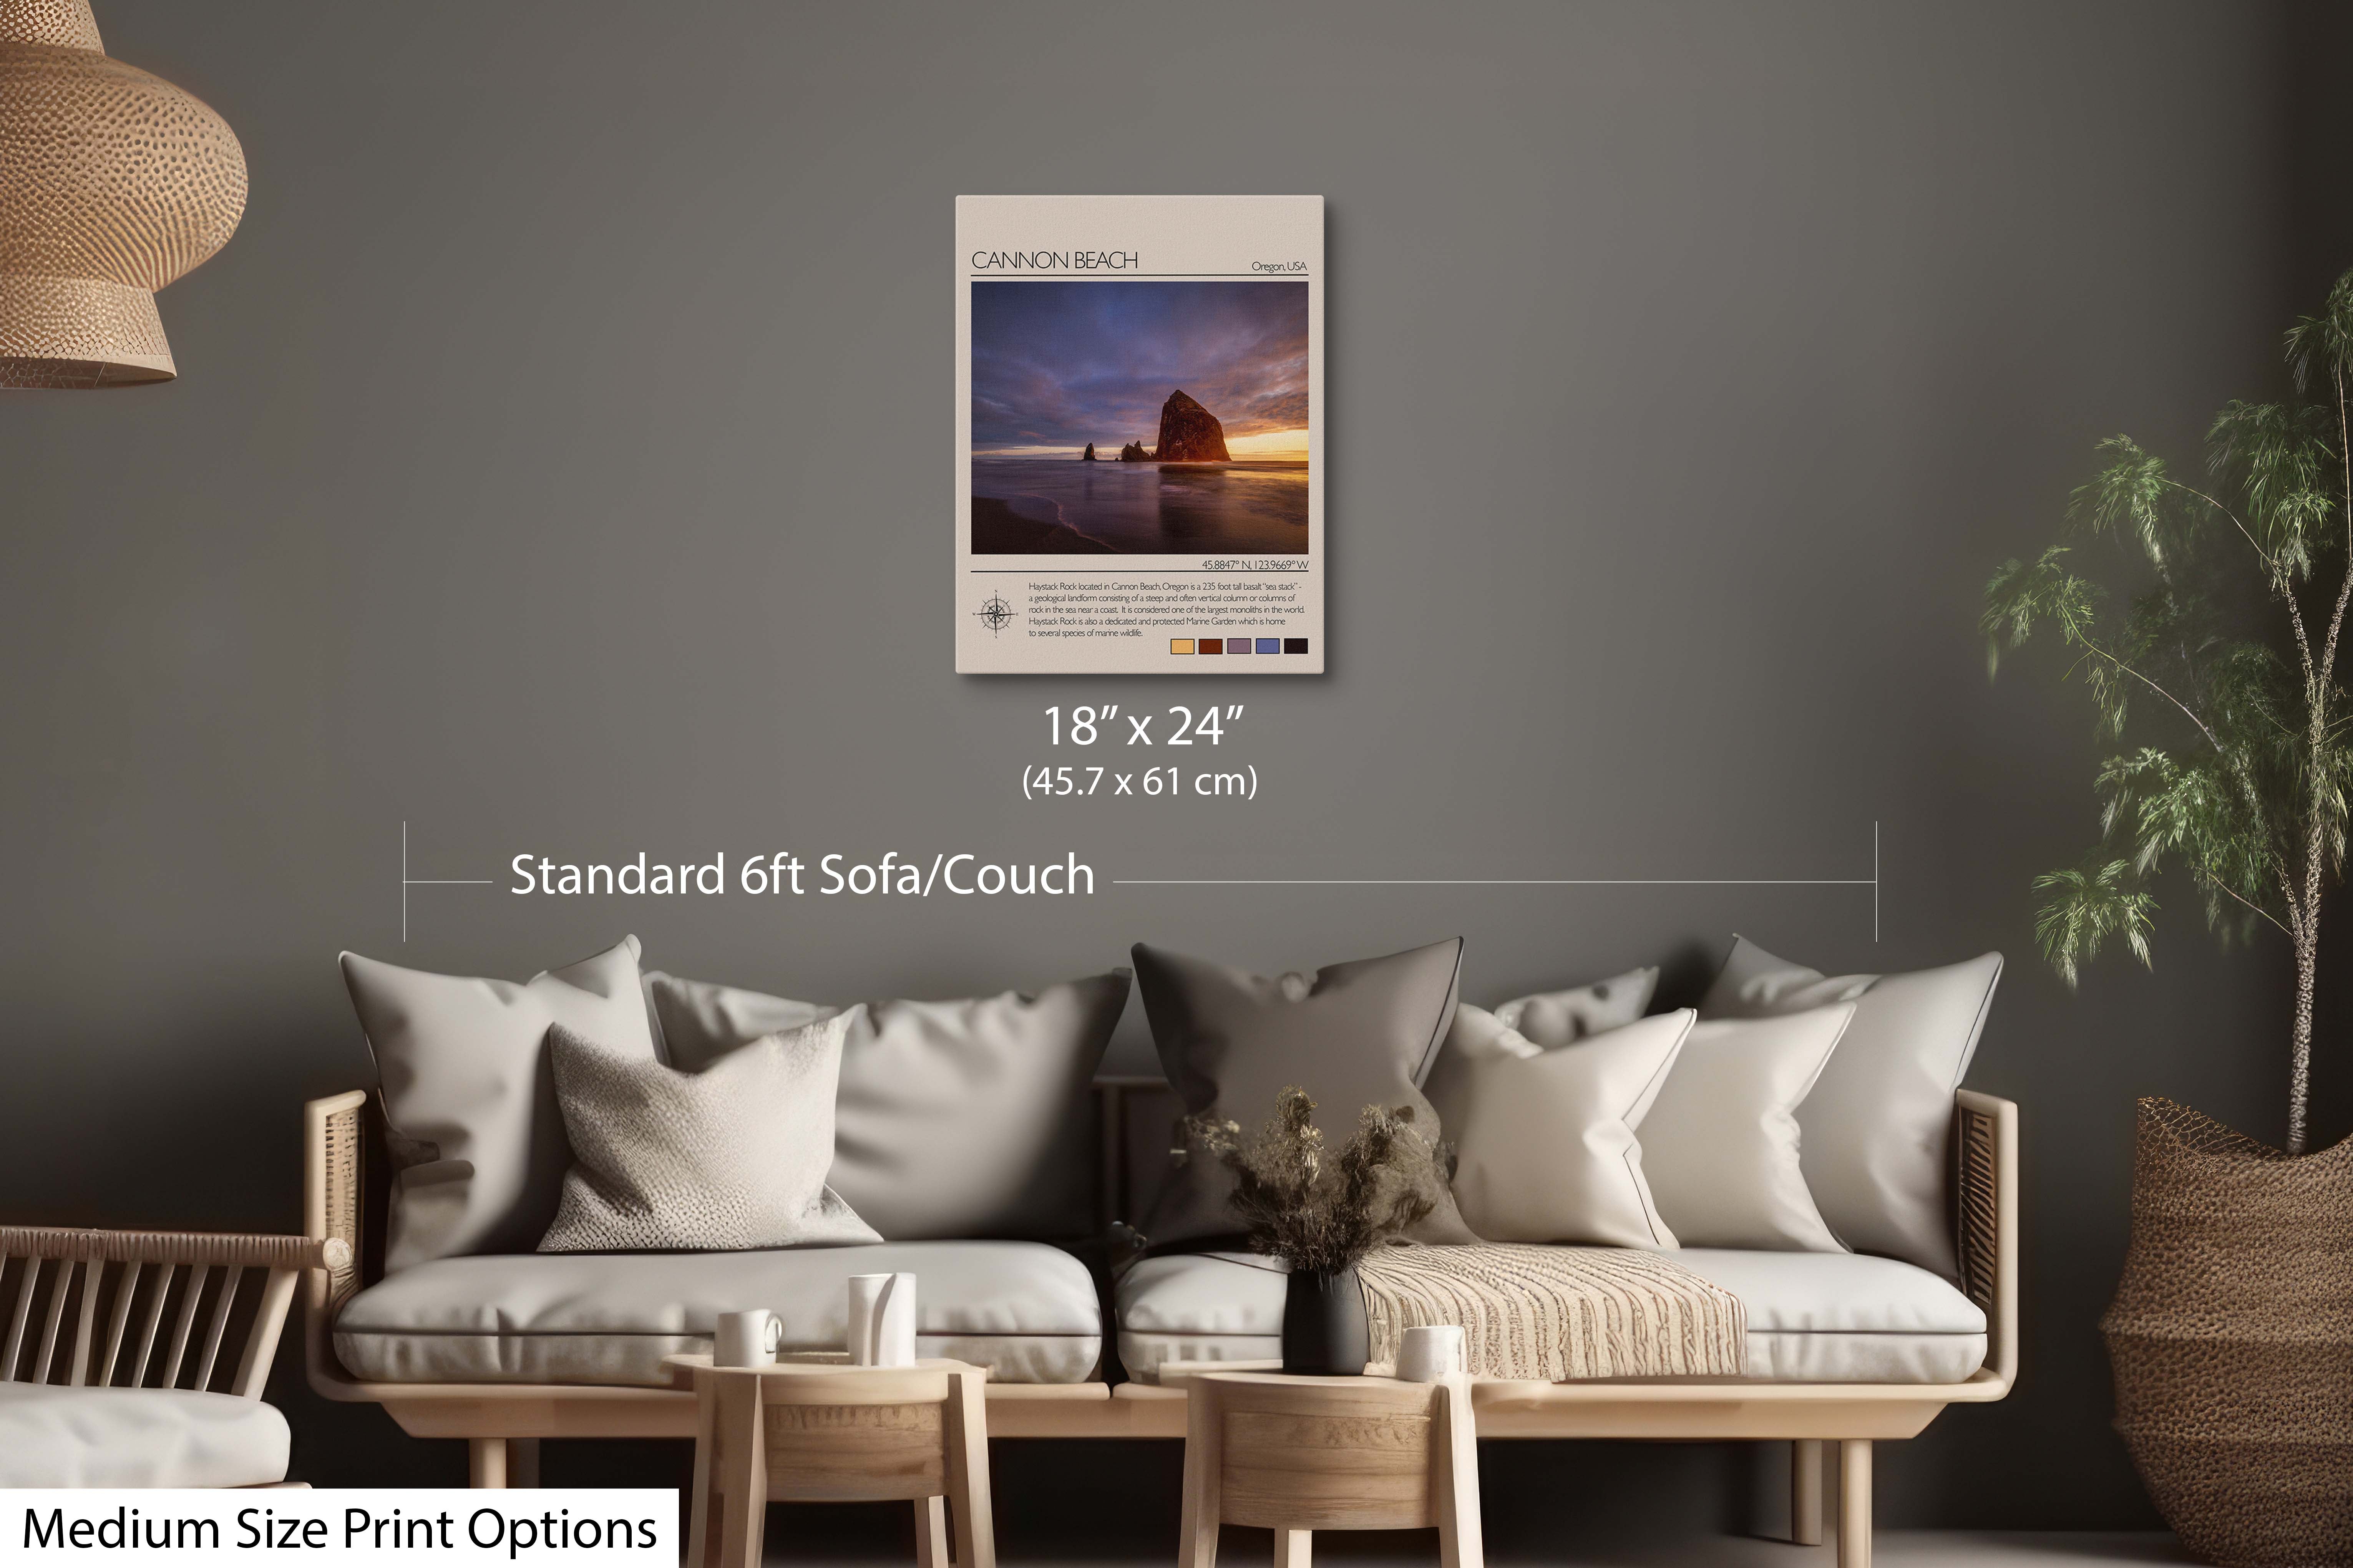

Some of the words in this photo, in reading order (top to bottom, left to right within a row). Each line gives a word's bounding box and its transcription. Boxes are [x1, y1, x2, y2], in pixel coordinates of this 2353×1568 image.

[972, 251, 1069, 269] CANNON
[1075, 251, 1138, 269] BEACH
[1251, 261, 1286, 273] Oregon,
[1287, 261, 1308, 271] USA
[1029, 582, 1059, 592] Haystack
[1060, 582, 1077, 590] Rock
[1078, 582, 1102, 590] located
[1111, 582, 1138, 590] Cannon
[1140, 582, 1162, 591] Beach,
[1162, 582, 1189, 593] Oregon
[1190, 582, 1195, 590] is
[1202, 582, 1216, 590] 235
[1217, 582, 1231, 590] foot
[1232, 582, 1242, 590] tall
[1243, 582, 1262, 590] basalt
[1034, 594, 1066, 604] geological
[1067, 593, 1097, 602] landform
[1099, 594, 1130, 604] consisting
[1131, 593, 1140, 602] of
[1145, 595, 1164, 604] steep
[1165, 594, 1178, 602] and
[1179, 593, 1197, 602] often
[1198, 593, 1221, 602] vertical
[1223, 594, 1248, 602] column
[1258, 594, 1287, 602] columns
[1288, 593, 1296, 602] of
[1029, 605, 1044, 613] rock
[1052, 605, 1064, 613] the
[1122, 605, 1127, 613] It
[1128, 605, 1133, 613] is
[1133, 605, 1170, 614] considered
[1186, 605, 1194, 613] of
[1194, 605, 1206, 613] the
[1207, 605, 1229, 616] largest
[1230, 605, 1263, 613] monoliths
[1271, 605, 1283, 613] the
[1283, 605, 1305, 613] world.
[1029, 617, 1059, 627] Haystack
[1060, 617, 1077, 625] Rock
[1078, 617, 1084, 625] is
[1084, 617, 1098, 625] also
[1105, 617, 1137, 625] dedicated
[1138, 617, 1151, 625] and
[1152, 617, 1185, 627] protected
[1186, 617, 1210, 625] Marine
[1211, 617, 1237, 625] Garden
[1238, 617, 1258, 625] which
[1259, 617, 1264, 625] is
[1266, 617, 1286, 625] home
[1037, 629, 1060, 637] several
[1062, 629, 1085, 639] species
[1086, 628, 1095, 637] of
[1095, 629, 1119, 637] marine
[1119, 628, 1143, 637] wildlife.
